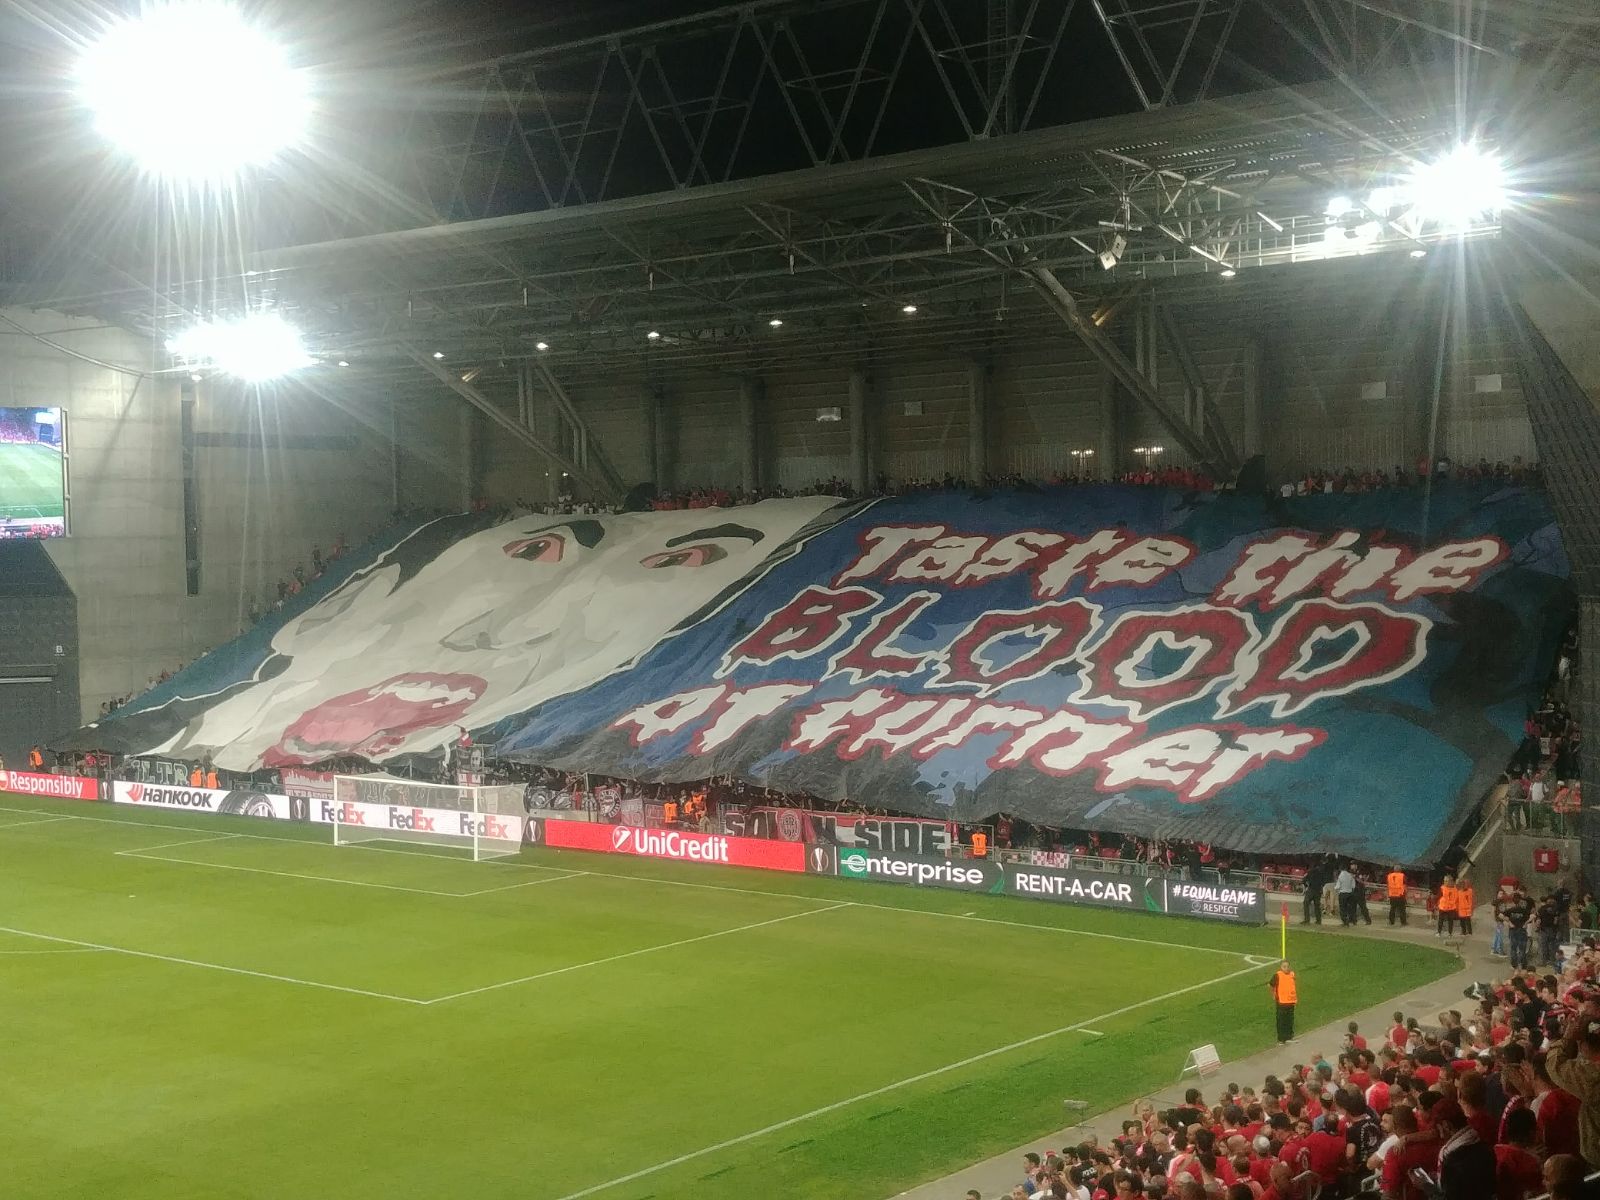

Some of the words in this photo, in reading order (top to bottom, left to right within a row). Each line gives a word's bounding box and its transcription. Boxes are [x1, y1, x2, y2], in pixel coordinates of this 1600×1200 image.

[1212, 529, 1504, 605] the
[712, 584, 1434, 722] BLOOD
[10, 771, 83, 798] Responsibly
[321, 801, 365, 824] FedEx
[389, 806, 435, 831] FedEx
[459, 812, 508, 839] FedEx
[635, 829, 729, 862] UniCredit
[841, 854, 983, 884] enterprise
[1015, 872, 1132, 902] RENT-A-CAR
[1203, 902, 1239, 915] RESPECT
